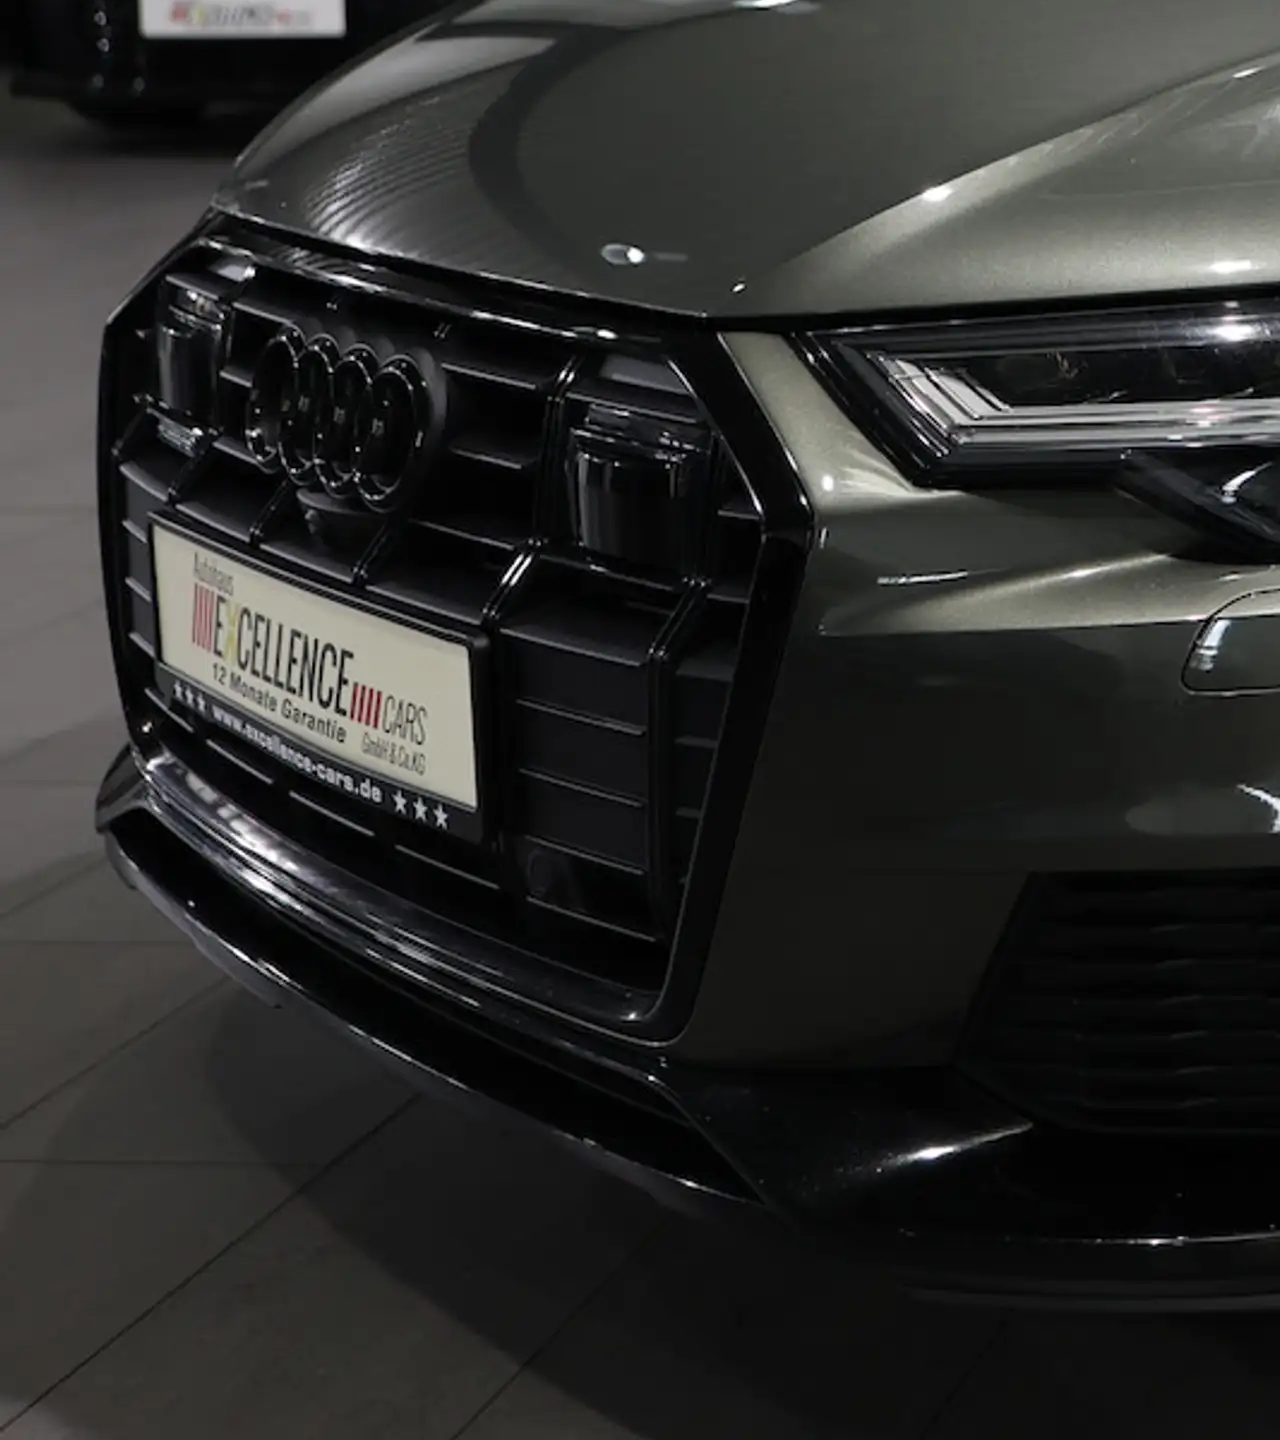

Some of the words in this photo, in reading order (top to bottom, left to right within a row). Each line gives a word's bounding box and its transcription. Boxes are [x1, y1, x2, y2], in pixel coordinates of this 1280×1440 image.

[213, 594, 355, 717] EXCELLENCE
[382, 695, 427, 745] CARS
[213, 662, 227, 685] 12
[229, 672, 278, 713] Monate
[281, 698, 347, 743] Garantie
[212, 704, 382, 803] www.excellence-cars.de
